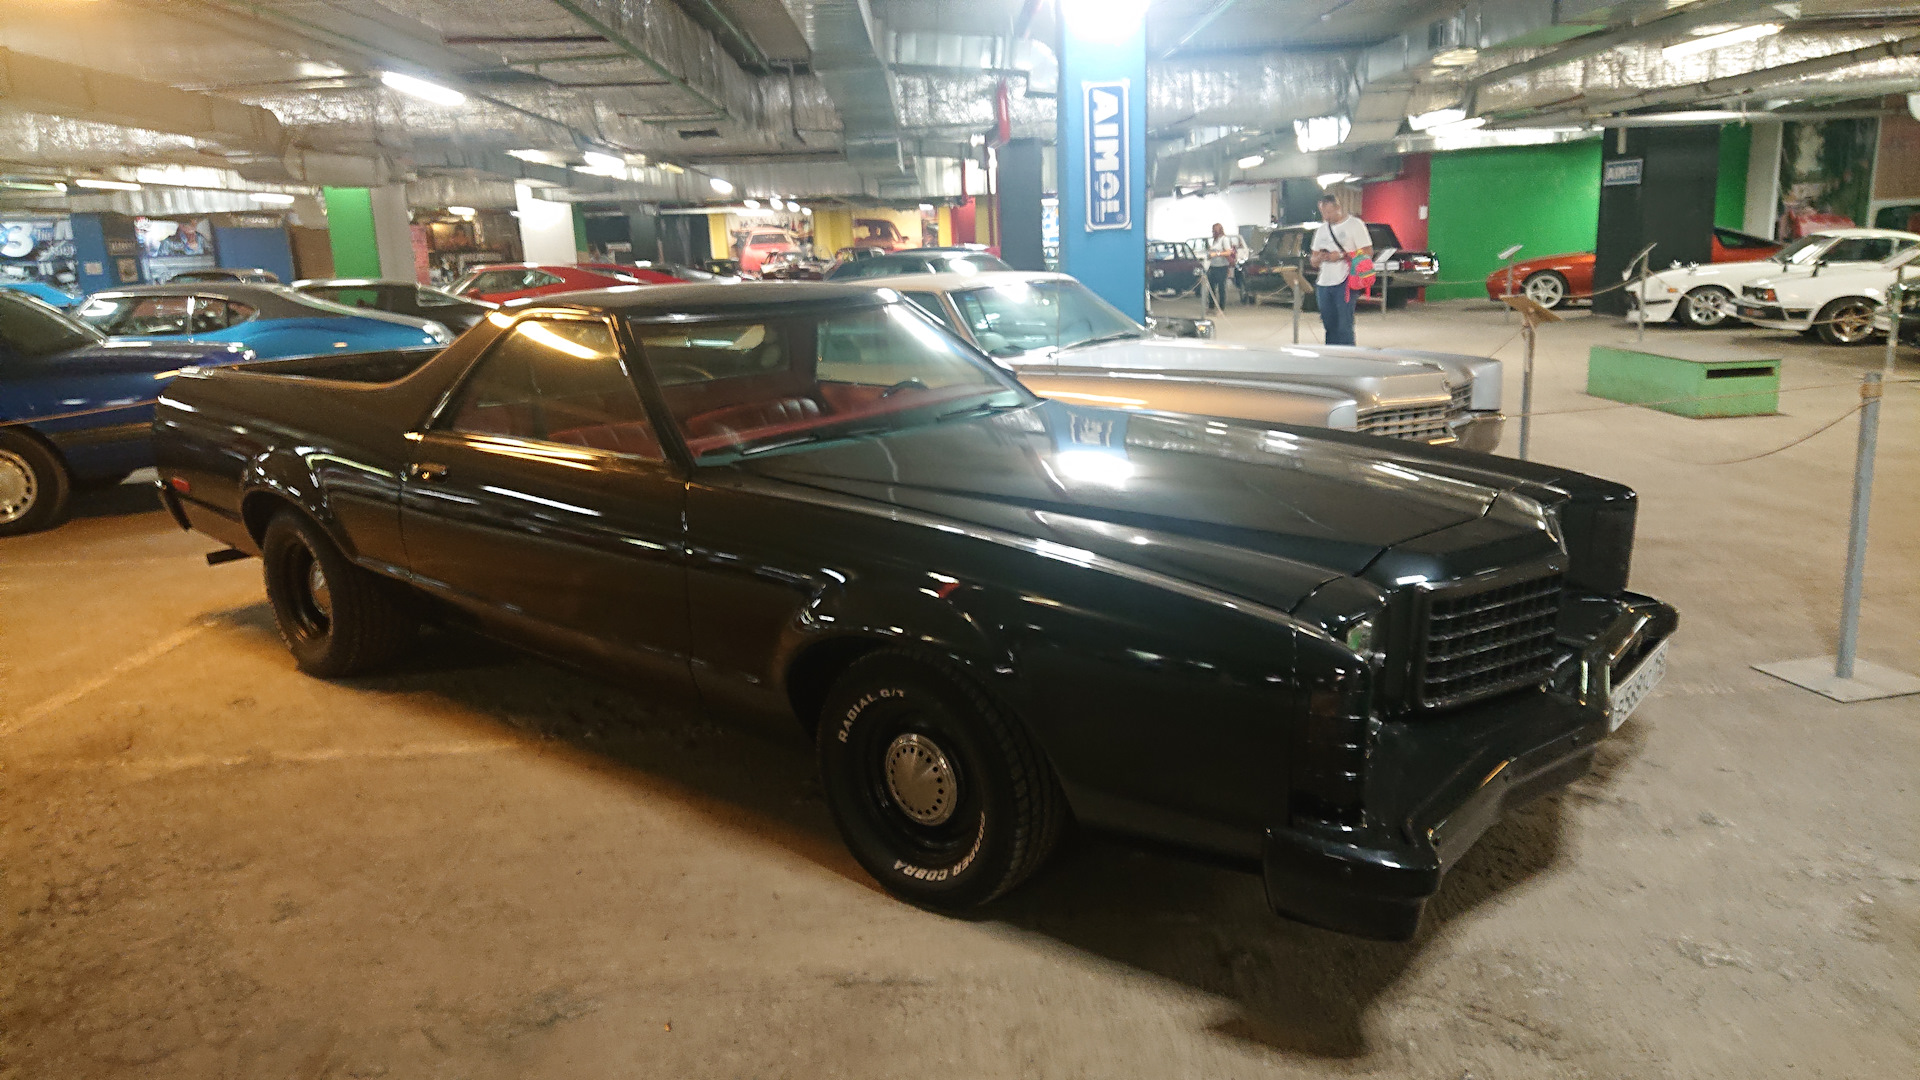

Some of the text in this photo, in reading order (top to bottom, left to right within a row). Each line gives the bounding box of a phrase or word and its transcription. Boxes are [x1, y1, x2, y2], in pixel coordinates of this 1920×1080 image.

[1093, 89, 1120, 223] AIMOL
[838, 694, 878, 743] RADIAL
[893, 859, 948, 881] COBRA
